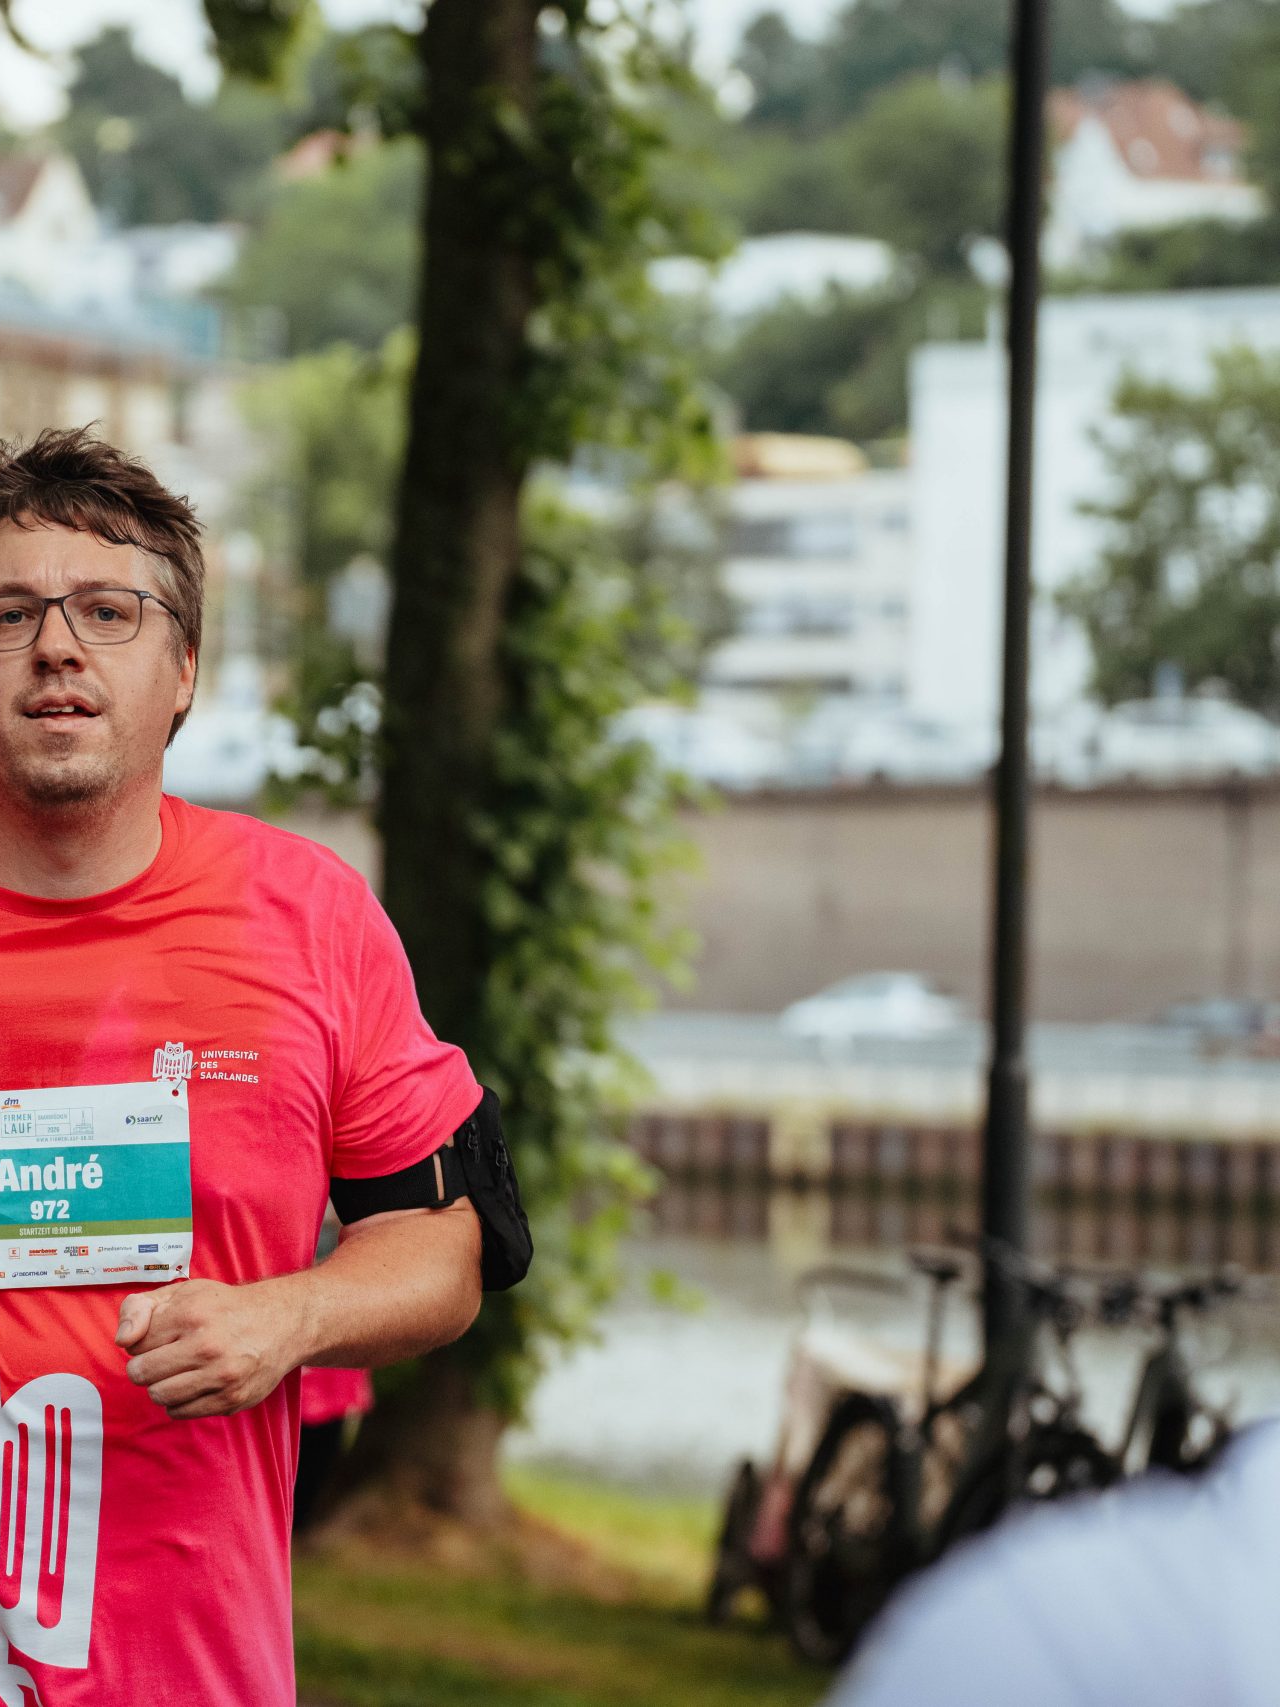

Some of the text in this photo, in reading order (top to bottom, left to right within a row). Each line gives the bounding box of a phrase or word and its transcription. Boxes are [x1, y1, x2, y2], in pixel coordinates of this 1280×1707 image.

[201, 1050, 259, 1060] UNIVERSITÄT
[200, 1072, 259, 1084] SAARLANDES
[4, 1097, 19, 1106] dm
[3, 1113, 32, 1121] FIRMEN
[4, 1122, 32, 1134] LAUF
[30, 1200, 70, 1220] 972
[19, 1227, 51, 1236] STARTZEIT
[69, 1226, 83, 1234] UHR
